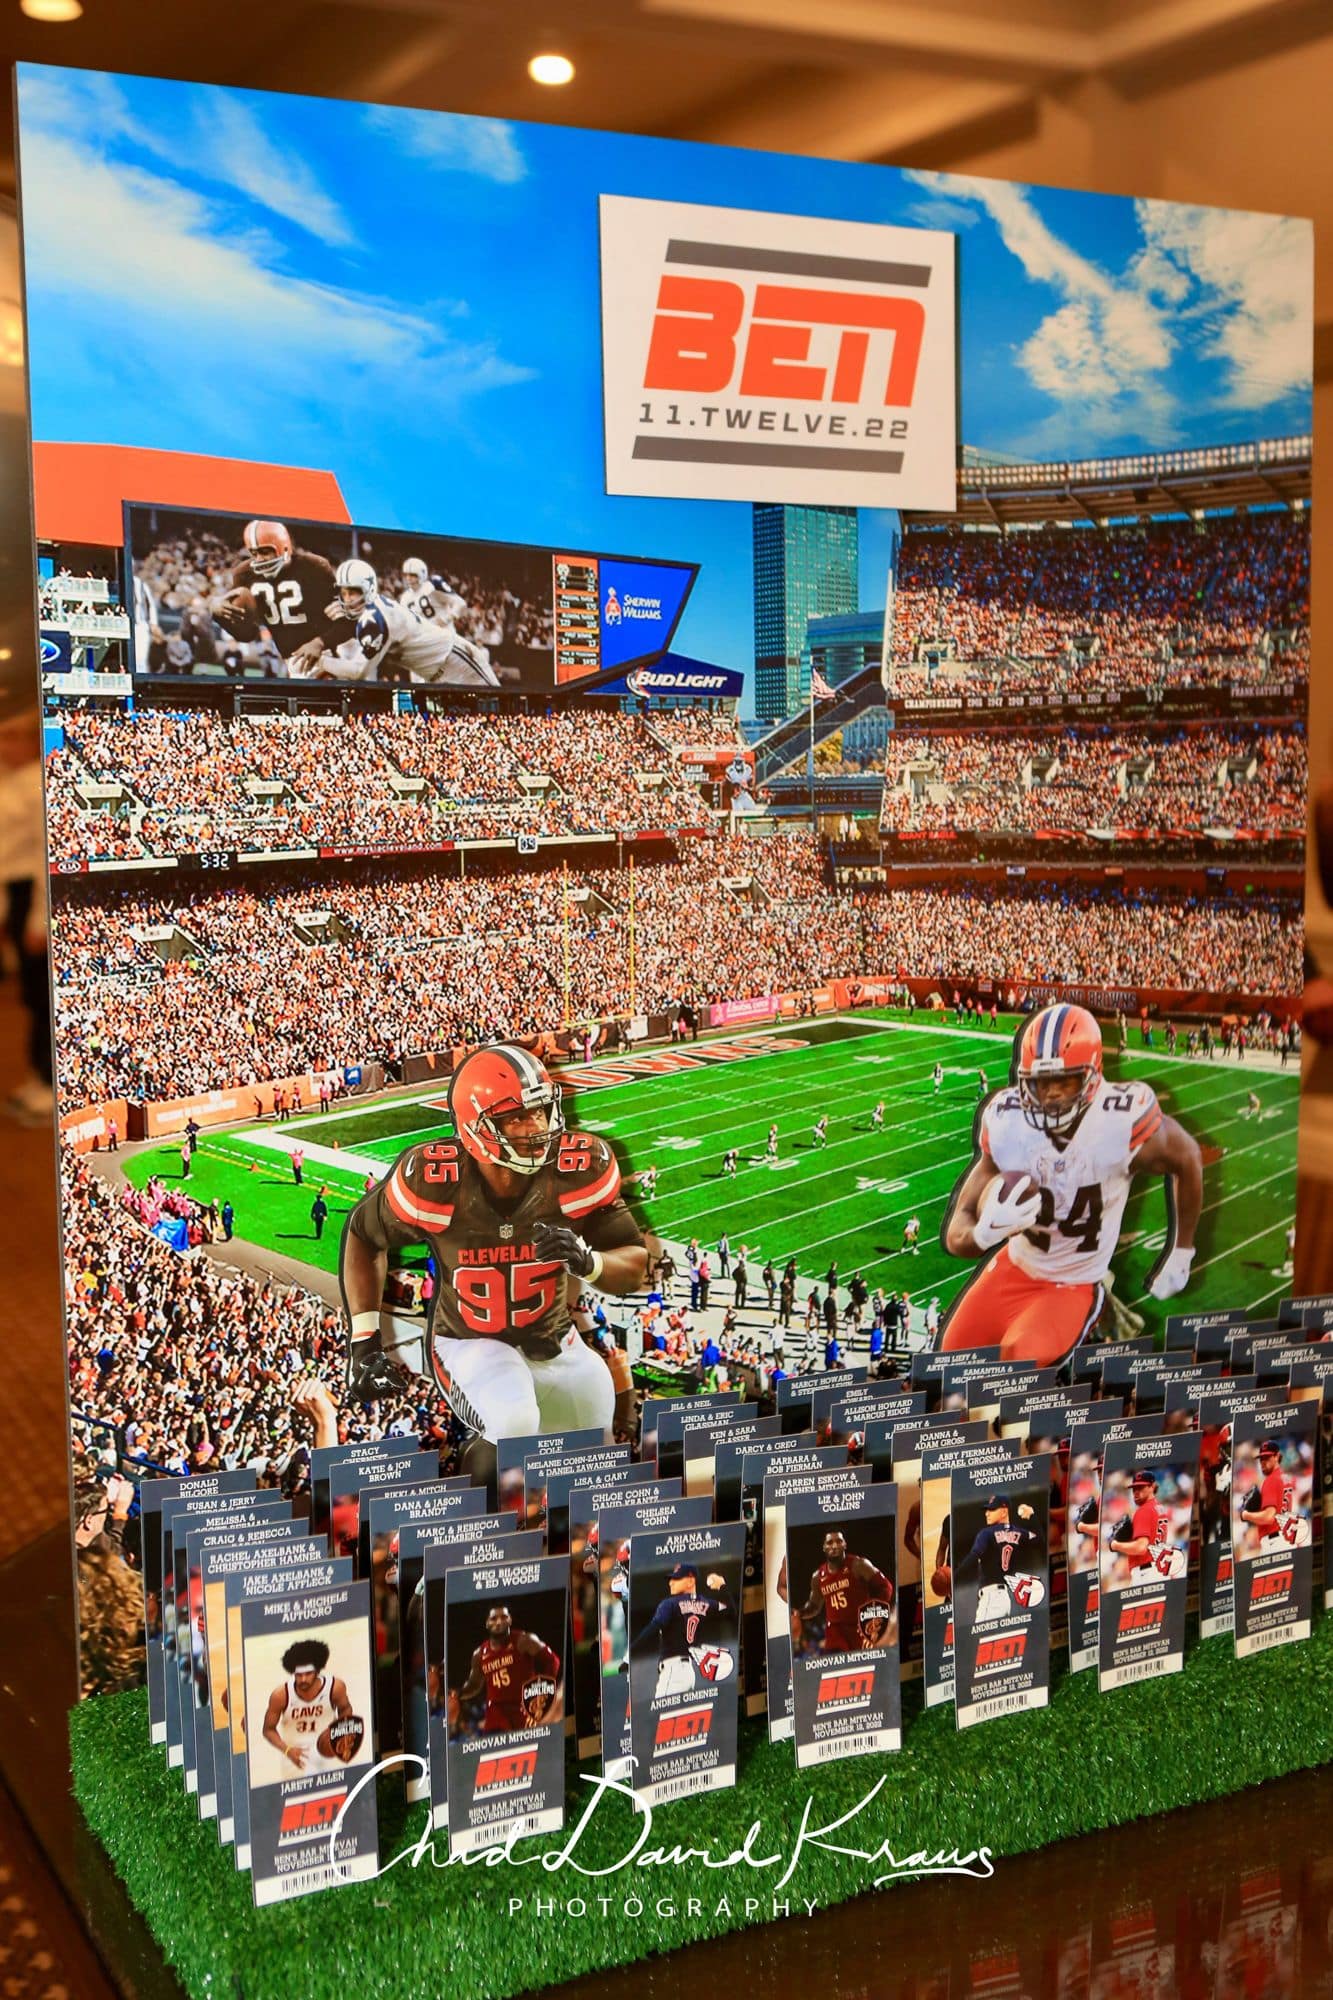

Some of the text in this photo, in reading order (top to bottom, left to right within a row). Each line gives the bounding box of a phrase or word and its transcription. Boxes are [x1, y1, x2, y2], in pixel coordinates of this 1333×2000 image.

[643, 274, 926, 408] BEN
[639, 402, 909, 439] 11.TWELVE.22
[623, 594, 661, 608] SHERWIN
[200, 853, 229, 869] 5:32
[453, 1261, 562, 1334] 95
[820, 1374, 854, 1385] HOWARD
[1018, 1375, 1039, 1385] ANDY
[670, 1399, 712, 1413] JILL NEIL
[844, 1404, 876, 1415] ALLISON
[877, 1399, 913, 1412] HOWARD
[1026, 1394, 1059, 1405] MELANIE
[680, 1410, 734, 1424] LINDA ERIC
[854, 1406, 911, 1422] MARCUS RIDGE
[1065, 1408, 1090, 1418] ANGIE
[710, 1425, 756, 1441] KEN SARA
[893, 1422, 923, 1433] JEREMY
[538, 1438, 564, 1448] KEVIN
[915, 1436, 966, 1451] ADAM GROSS
[919, 1432, 950, 1443] JOANNA
[350, 1446, 380, 1458] STACY
[735, 1439, 798, 1455] DARCY GREG
[1136, 1441, 1173, 1452] MICHAEL
[771, 1455, 810, 1466] BARBARA
[929, 1452, 1012, 1472] MICHAEL GROSSMAN
[938, 1447, 998, 1462] ABBY FIERMAN
[1135, 1449, 1172, 1460] HOWARD
[358, 1460, 411, 1476] KATIE JON
[527, 1459, 562, 1471] MELANIE
[546, 1464, 575, 1477] DANIEL
[767, 1461, 823, 1474] BOB FIERMAN
[969, 1461, 1033, 1479] LINDSAY NICK
[179, 1479, 219, 1491] DONALD
[369, 1471, 402, 1484] BROWN
[573, 1477, 593, 1488] LISA
[603, 1471, 629, 1483] GARY
[780, 1474, 848, 1489] DARREN ESKOW
[975, 1471, 1028, 1486] GOUREVITCH
[418, 1484, 447, 1495] MITCH
[592, 1488, 652, 1504] CHLOE COHN
[186, 1496, 257, 1512] SUSAN JERRY
[394, 1495, 462, 1513] DANA JASON
[817, 1491, 865, 1505] LIZ JOHN
[409, 1507, 448, 1519] BRANDT
[635, 1506, 677, 1519] CHELSEA
[822, 1501, 861, 1513] COLLINS
[206, 1514, 247, 1527] MELISSA
[642, 1516, 669, 1527] COHN
[203, 1526, 292, 1547] CRAIG REBECCA
[417, 1520, 500, 1539] MARC REBECCA
[433, 1531, 483, 1545] BLUMBERG
[666, 1533, 703, 1546] ARIANA
[472, 1543, 497, 1555] PAUL
[655, 1538, 721, 1556] DAVID COHEN
[210, 1546, 301, 1565] RACHEL AXELBANK
[463, 1551, 504, 1565] BILGORE
[208, 1552, 322, 1575] CHRISTOPHER HAMNER
[243, 1569, 325, 1589] JAKE AXELBANK
[472, 1563, 541, 1582] MEG BILGORE
[245, 1576, 332, 1596] NICOLE AFFLECK
[484, 1574, 541, 1589] ED WOODS
[263, 1591, 348, 1616] MIKE MICHELE
[830, 1592, 848, 1611] 45
[282, 1606, 332, 1623] AUTUORO
[971, 1621, 998, 1635] ANDRES
[805, 1649, 887, 1671] DONOVAN MITCHELL
[492, 1668, 511, 1689] 45
[972, 1686, 1008, 1700] NOVEMBER
[650, 1695, 681, 1711] ANDRES
[291, 1705, 323, 1720] CAVS
[296, 1720, 317, 1733] 31
[833, 1718, 848, 1729] BAR
[814, 1724, 854, 1740] NOVEMBER
[462, 1726, 551, 1754] DONOVAN MITCHELL
[671, 1758, 685, 1770] BAR
[651, 1766, 691, 1783] NOVEMBER
[281, 1770, 345, 1796] JARETT ALLEN
[492, 1801, 508, 1813] BAR
[471, 1808, 514, 1826] NOVEMBER
[274, 1847, 317, 1866] BEN'S BAR
[276, 1854, 325, 1874] NOVEMBER
